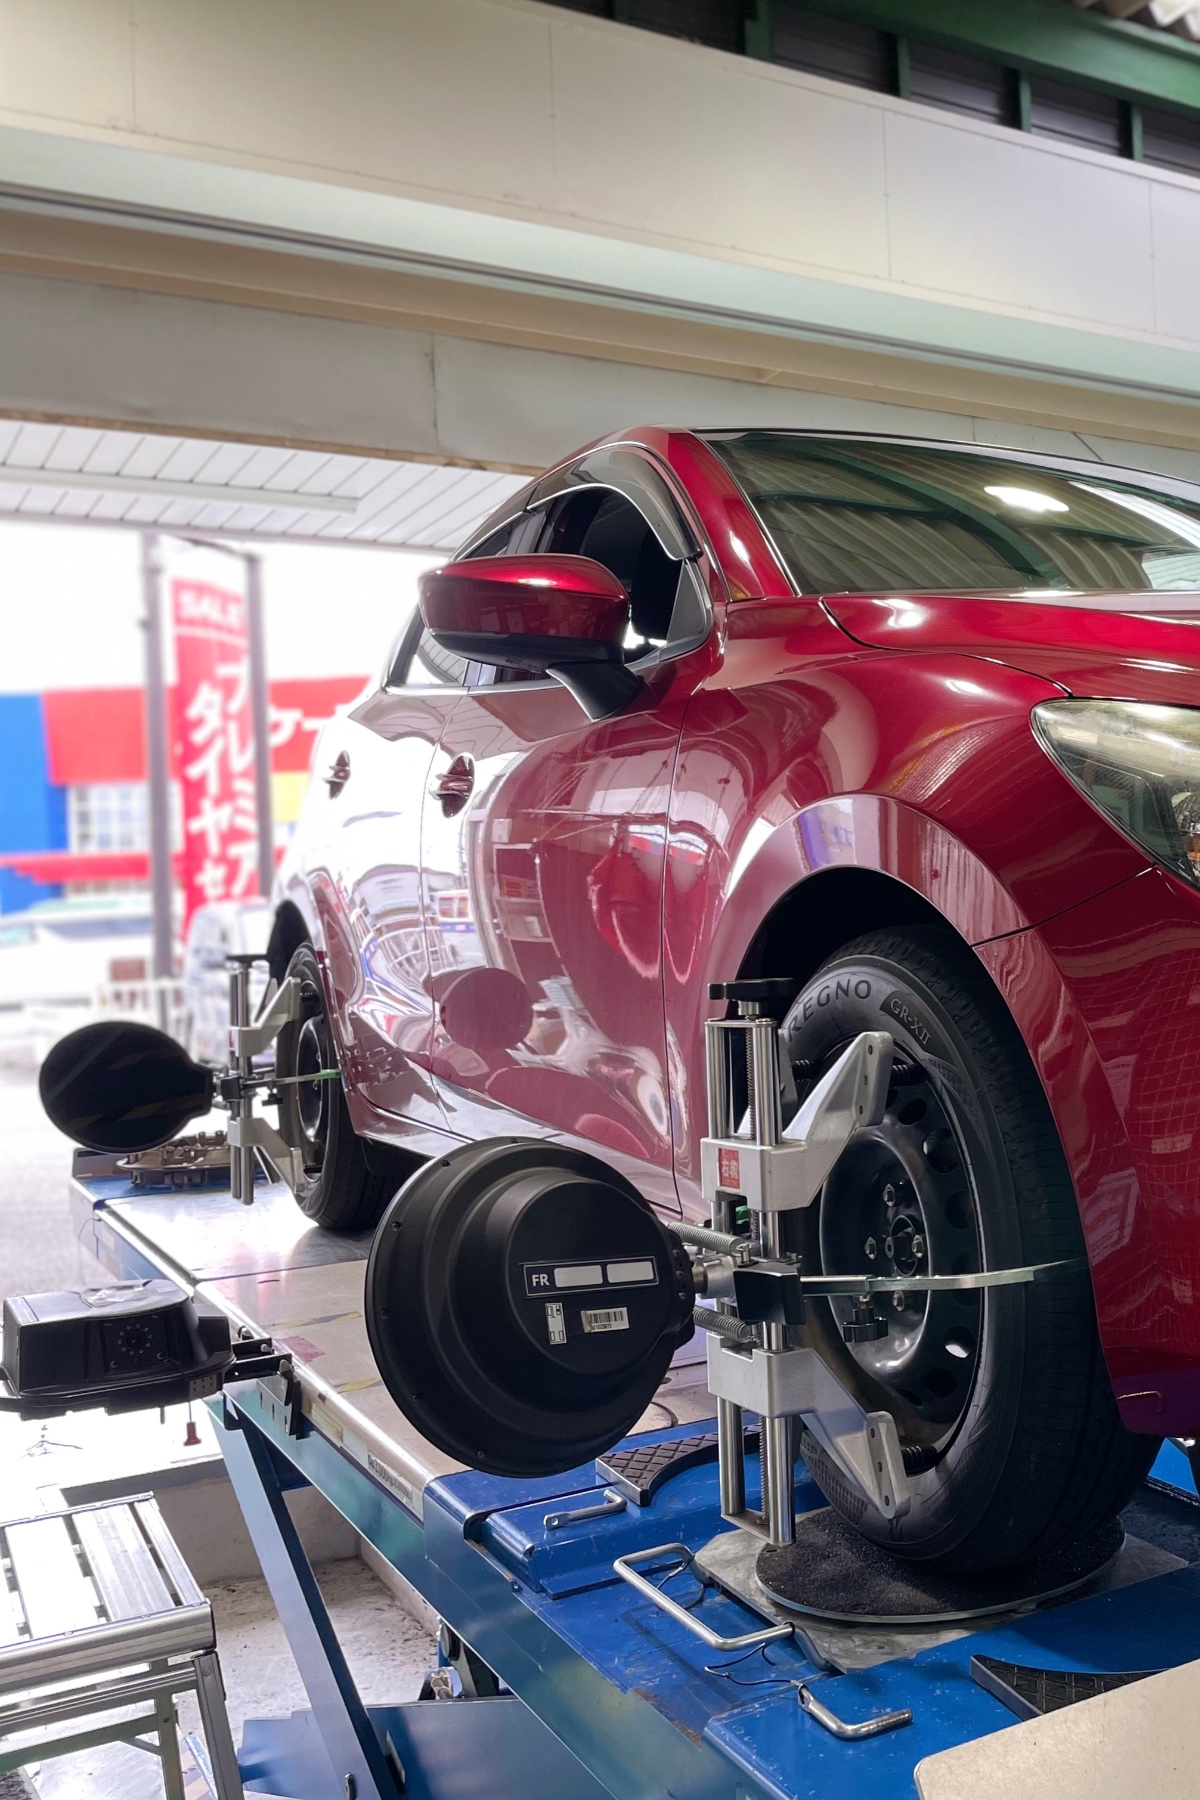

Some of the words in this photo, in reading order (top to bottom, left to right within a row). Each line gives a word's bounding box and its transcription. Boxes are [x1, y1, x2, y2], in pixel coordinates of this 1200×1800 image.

[179, 589, 244, 631] SALE
[788, 978, 872, 1043] REGNO
[531, 1273, 550, 1287] FR
